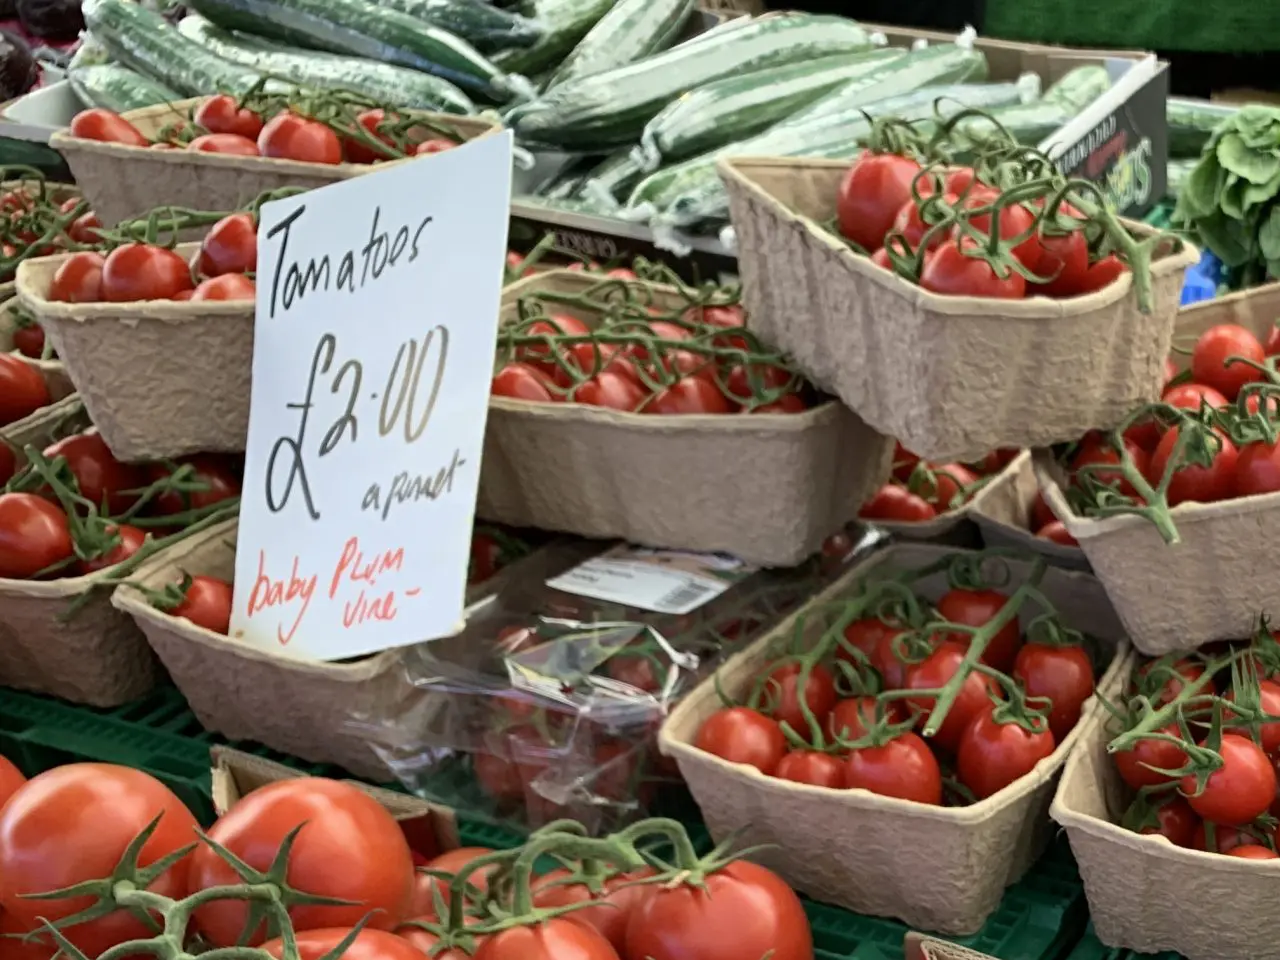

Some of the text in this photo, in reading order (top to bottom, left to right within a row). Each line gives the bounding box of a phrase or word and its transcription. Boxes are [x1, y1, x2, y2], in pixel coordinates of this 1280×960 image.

[267, 204, 433, 319] Tomatoes
[265, 325, 449, 520] £2.00
[247, 548, 318, 646] baby
